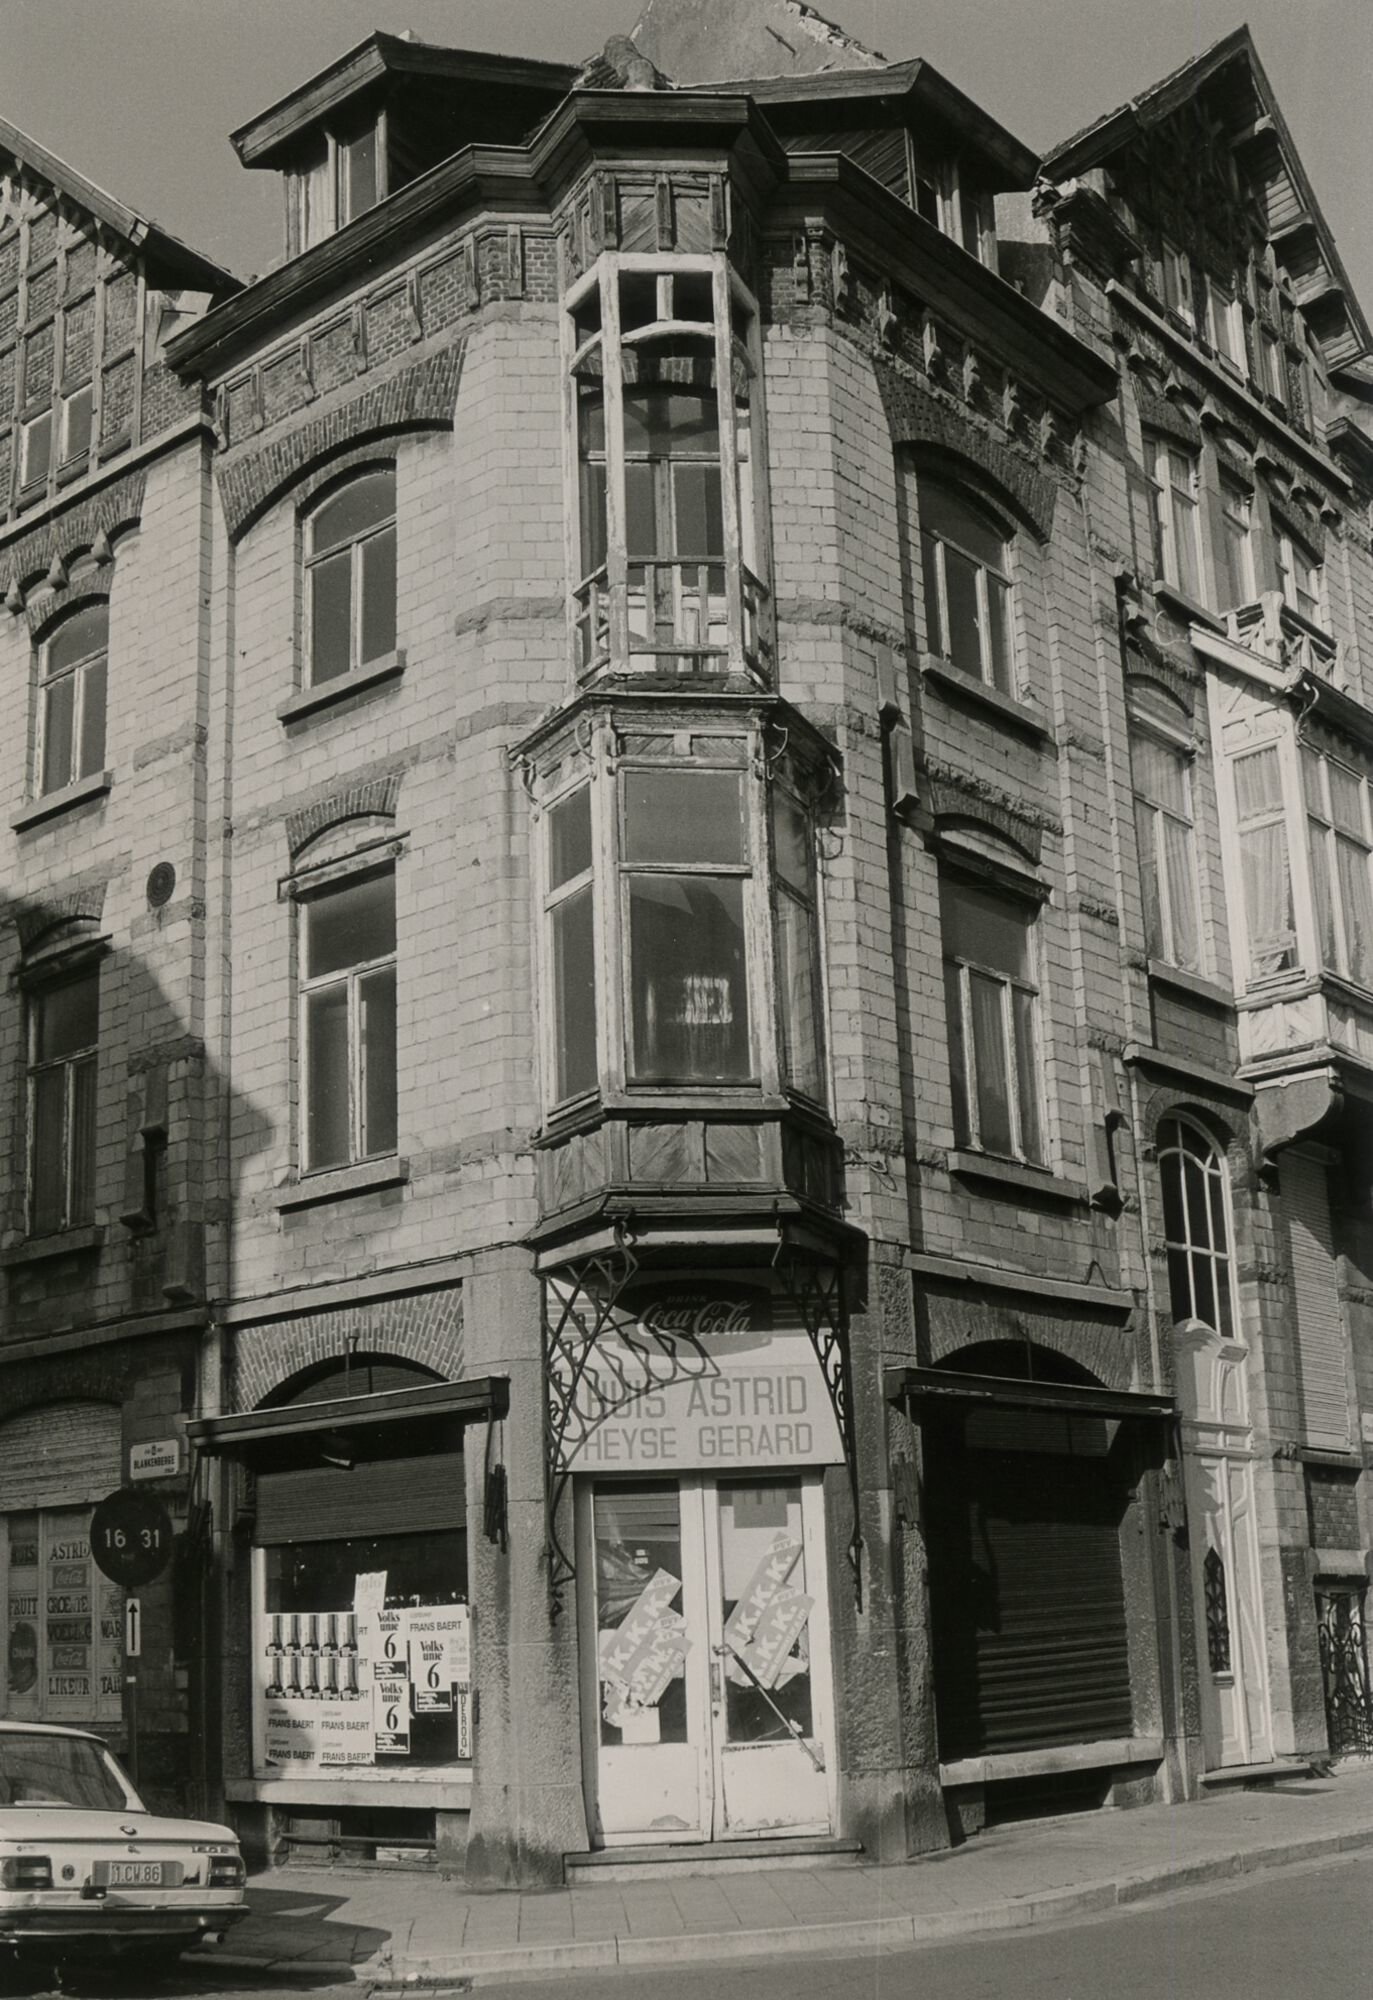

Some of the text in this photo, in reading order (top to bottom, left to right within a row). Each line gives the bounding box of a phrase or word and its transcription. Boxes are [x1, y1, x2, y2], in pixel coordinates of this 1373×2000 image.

[637, 1299, 752, 1336] Coca-Cola
[586, 1376, 808, 1420] HUIS ASTRID
[584, 1422, 813, 1461] HEYSE GERARD
[104, 1527, 159, 1548] 16 31
[50, 1541, 91, 1560] ASTRID
[9, 1597, 38, 1616] FRUIT
[46, 1596, 88, 1614] GROETE
[377, 1611, 401, 1623] Volks
[380, 1623, 399, 1632] unie
[410, 1620, 462, 1632] FRANS BAERT
[384, 1632, 398, 1660] 6
[420, 1640, 444, 1652] Volks
[422, 1652, 443, 1662] unie
[427, 1662, 441, 1689] 6
[48, 1677, 90, 1695] LIKEUR
[379, 1682, 403, 1694] Volks
[382, 1694, 401, 1703] unie
[385, 1704, 399, 1731] 6
[268, 1719, 315, 1729] FRANS BAERT
[321, 1721, 370, 1731] FRANS BAERT
[268, 1749, 315, 1761] FRANS BAERT
[322, 1752, 371, 1762] FRANS BAERT
